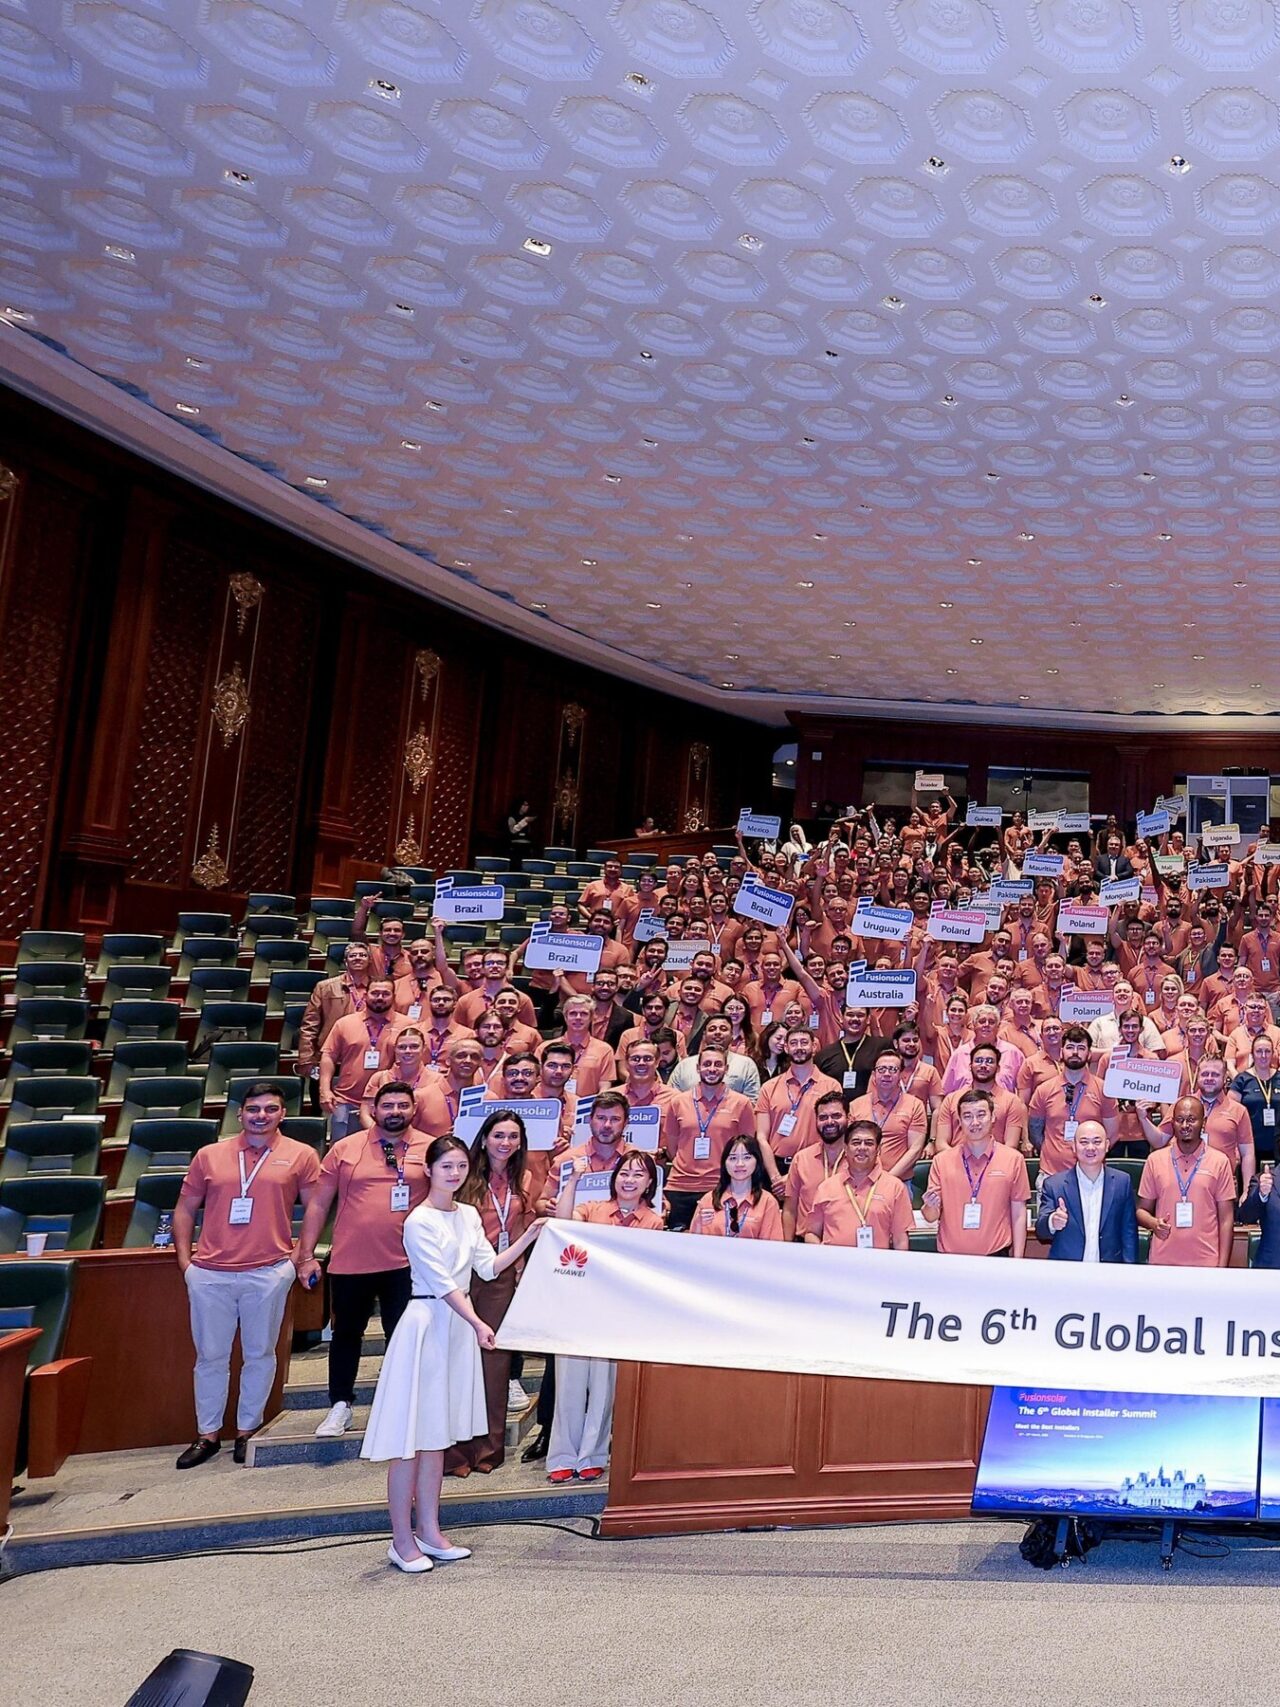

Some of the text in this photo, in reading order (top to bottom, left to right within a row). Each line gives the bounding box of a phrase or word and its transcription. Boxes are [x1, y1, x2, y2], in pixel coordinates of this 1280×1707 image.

[747, 825, 770, 834] Mexico
[1142, 823, 1164, 833] Tanzania
[1210, 834, 1232, 842] Uganda
[1028, 864, 1057, 873] Mauritius
[452, 889, 498, 899] Fusionsolar
[997, 891, 1021, 899] Pakista
[1105, 891, 1133, 901] Mongolia
[454, 904, 483, 914] Brazil
[751, 901, 773, 917] Brazil
[870, 908, 909, 920] Fusionsolar
[863, 921, 900, 935] Uruguay
[1070, 920, 1095, 929] Poland
[941, 925, 970, 936] Poland
[548, 935, 597, 949] Fusionsolar
[547, 951, 578, 964] Brazil
[865, 973, 910, 982] Fusionsolar
[858, 989, 904, 999] Australia
[1073, 1007, 1101, 1015] Poland
[1126, 1061, 1176, 1075] Fusionsolar
[1122, 1078, 1161, 1094] Poland
[554, 1268, 585, 1278] HUAWEI
[881, 1301, 962, 1341] The
[981, 1308, 1037, 1344] 6th
[1055, 1312, 1205, 1355] Global
[1019, 1393, 1067, 1403] Fusionsolar
[1019, 1406, 1035, 1415] The
[1051, 1407, 1080, 1417] Global
[1082, 1408, 1120, 1417] Installer
[1121, 1409, 1157, 1418] Summit
